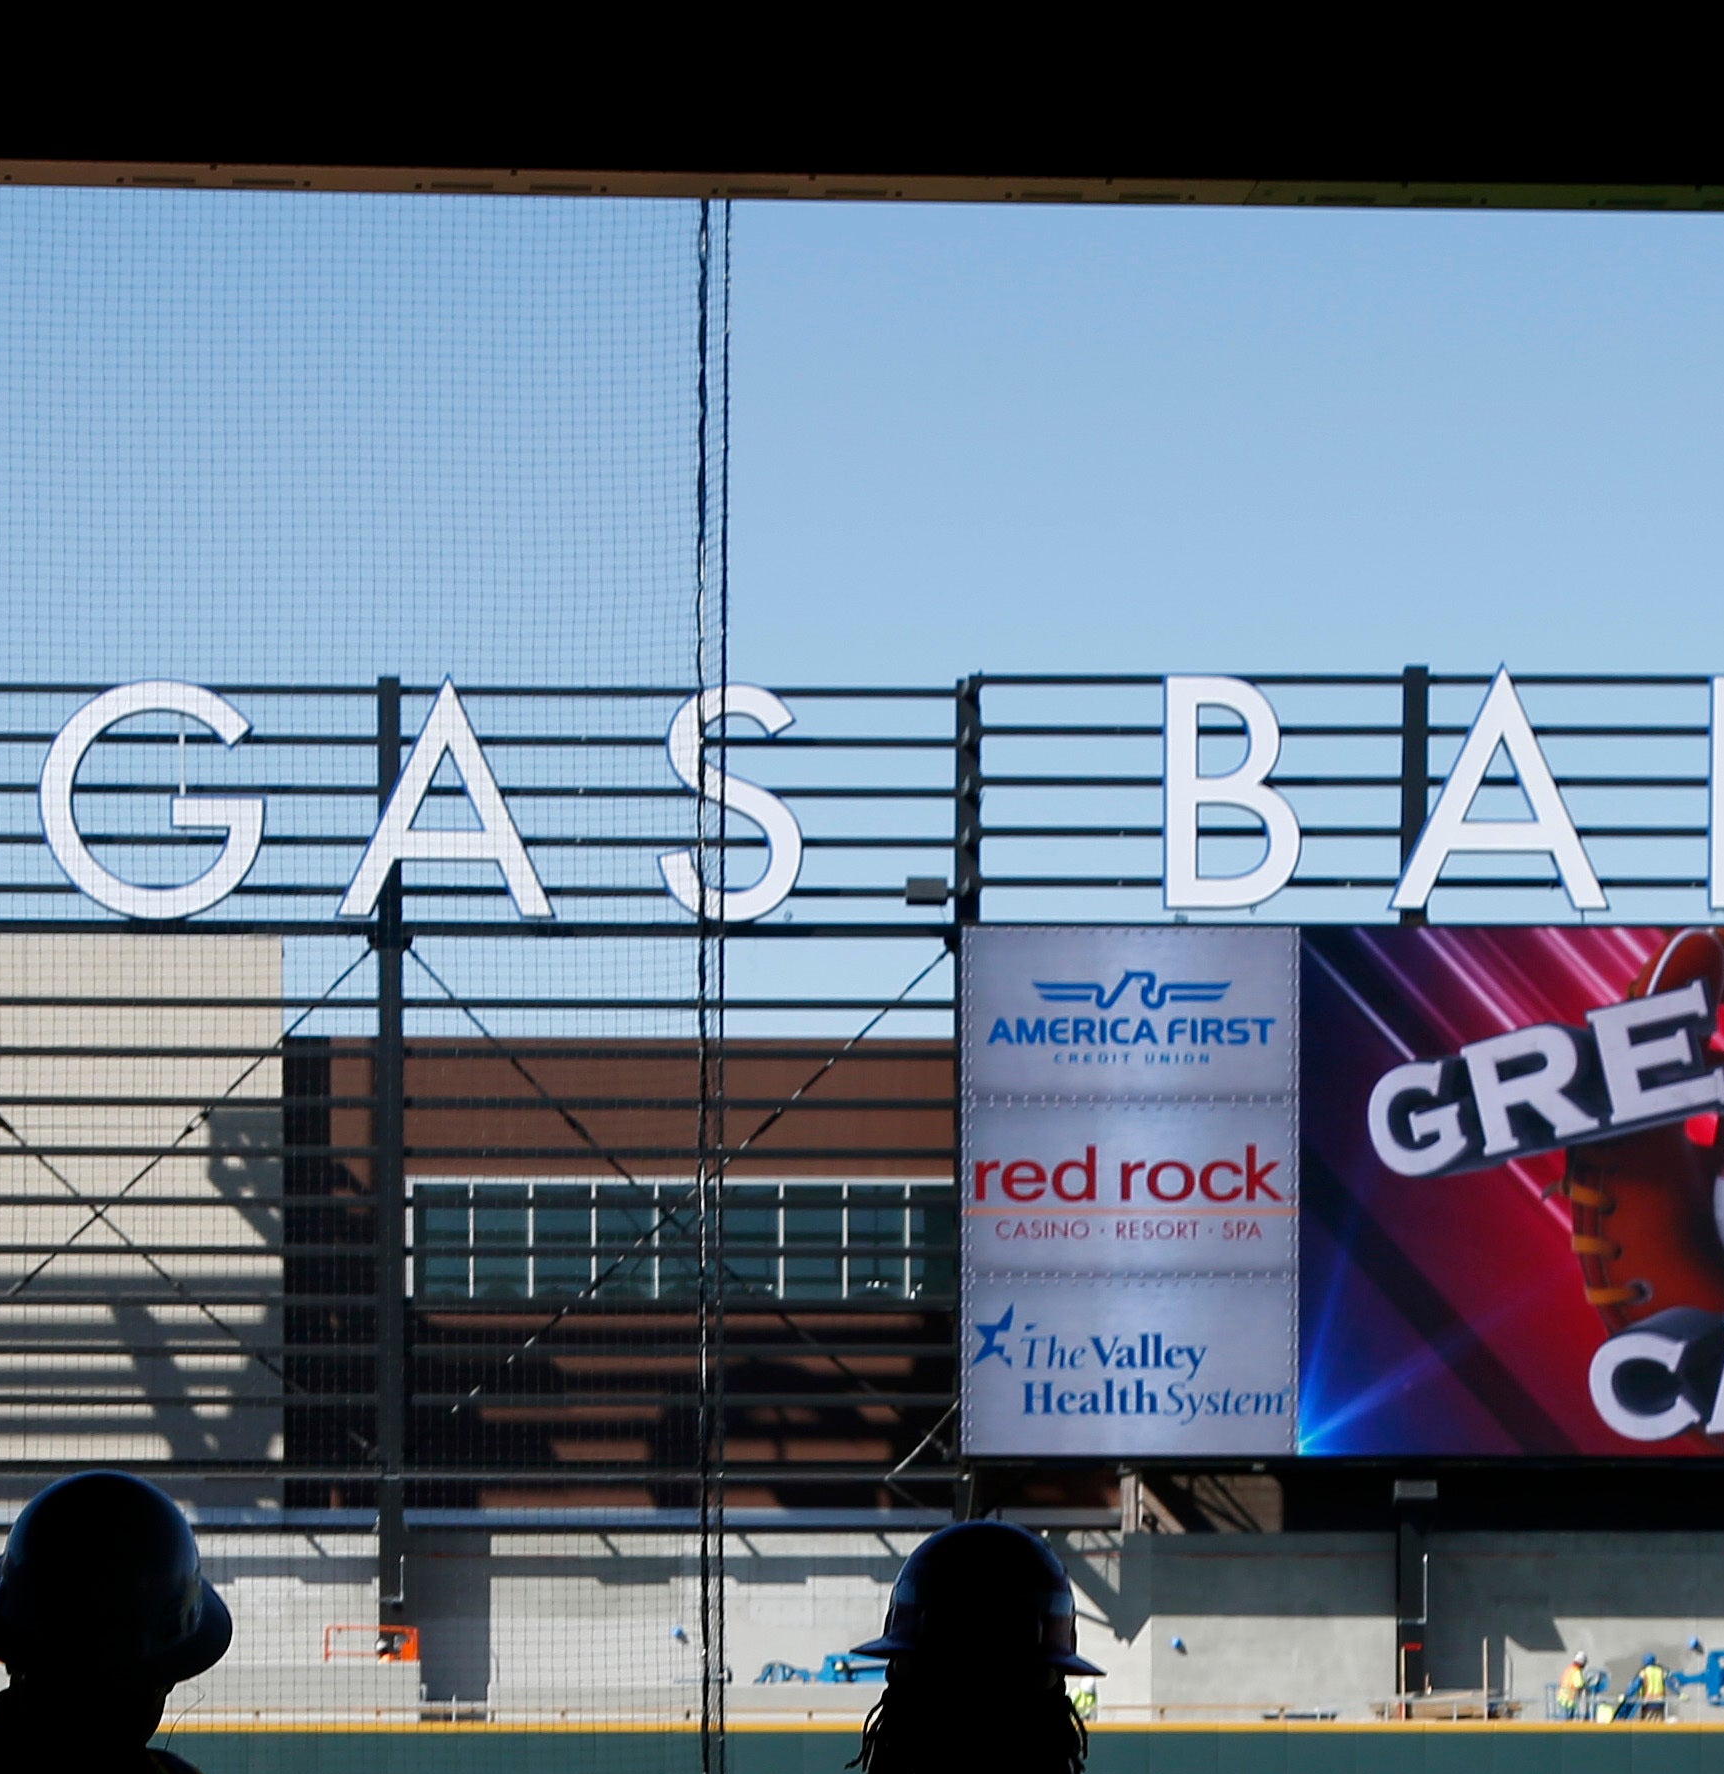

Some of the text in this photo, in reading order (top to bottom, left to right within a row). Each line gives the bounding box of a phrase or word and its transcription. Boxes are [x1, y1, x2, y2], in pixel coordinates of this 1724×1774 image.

[986, 1017, 1276, 1046] AMERICA FIRST
[1053, 1052, 1211, 1065] CREDIT UNION
[974, 1143, 1284, 1203] red rock
[995, 1219, 1263, 1241] CASINO RESORT SPA
[1020, 1332, 1208, 1381] The Valley
[1022, 1377, 1285, 1426] Health System
